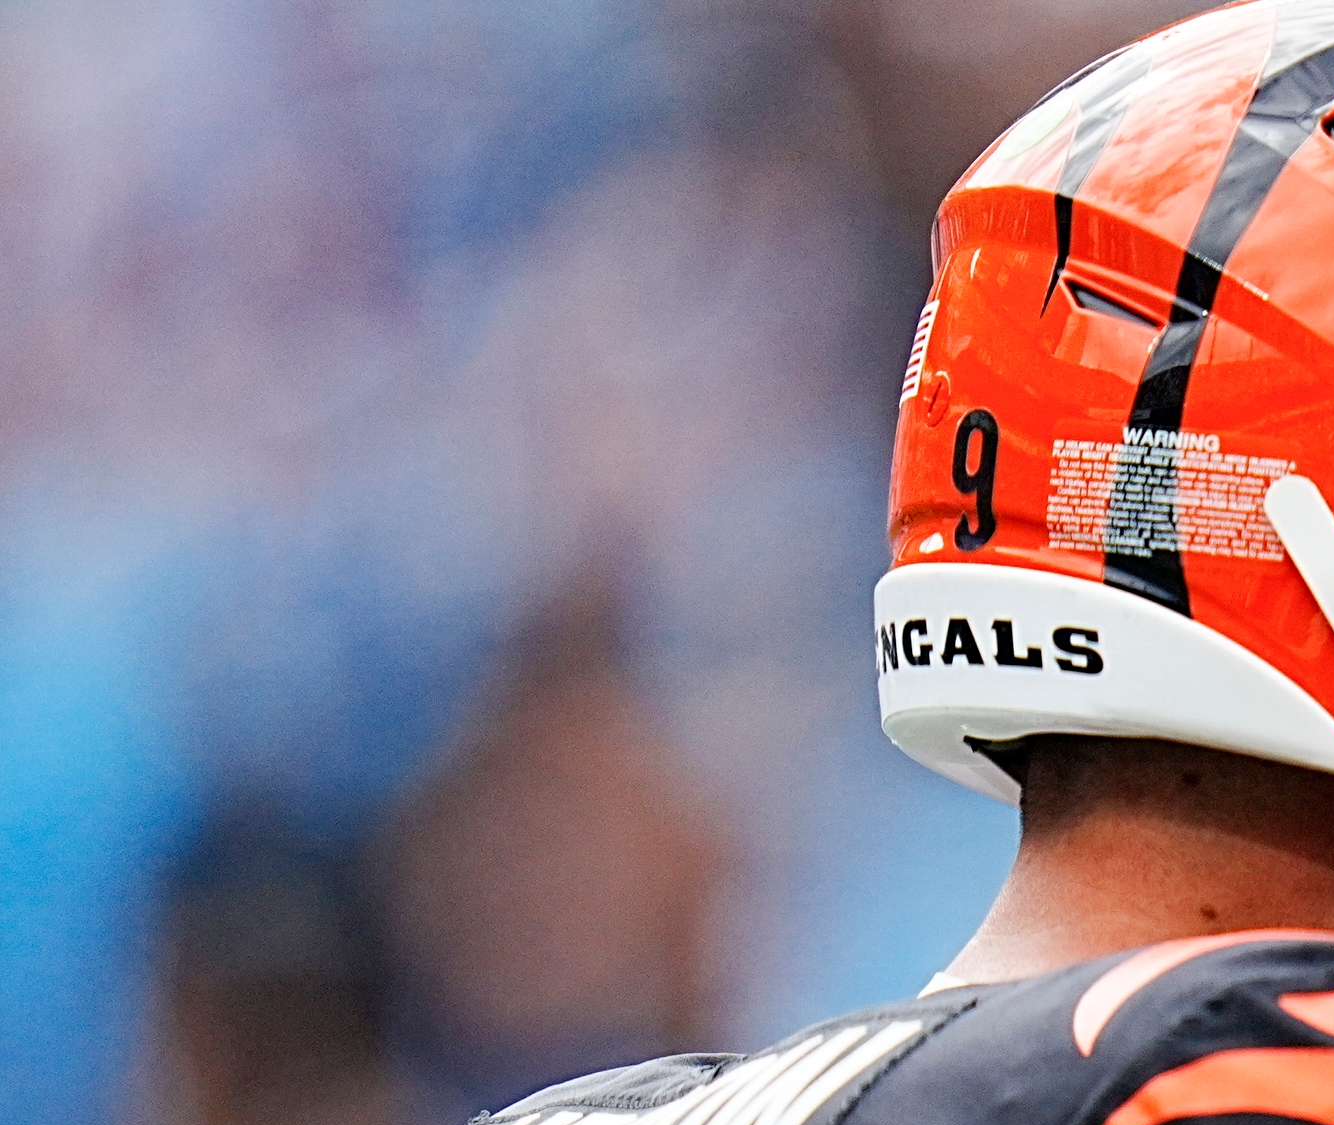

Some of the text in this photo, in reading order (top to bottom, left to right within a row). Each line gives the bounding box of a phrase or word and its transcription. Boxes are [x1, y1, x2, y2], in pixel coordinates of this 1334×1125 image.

[1065, 439, 1094, 451] HELMET
[1095, 441, 1112, 452] CAN
[1113, 443, 1148, 455] PREVENT
[1122, 427, 1220, 452] WARNING
[1052, 447, 1080, 459] PLAYER
[1081, 449, 1107, 461] MIGHT
[1058, 459, 1068, 467] Do
[1068, 460, 1080, 468] not
[951, 409, 999, 551] 9
[876, 617, 1105, 675] NGALS
